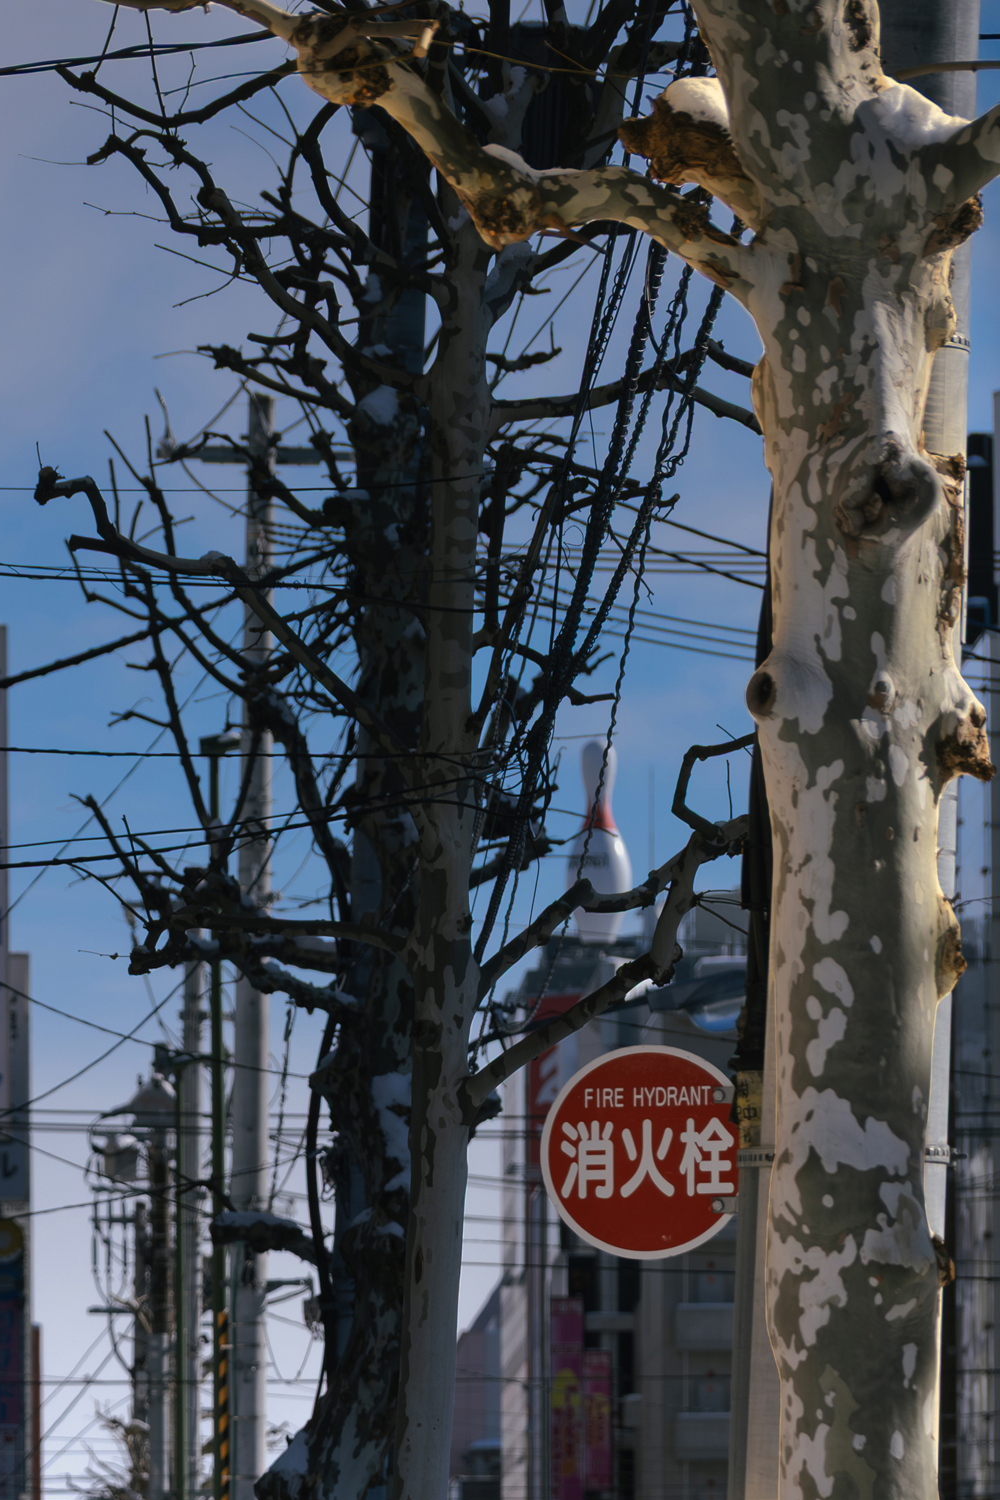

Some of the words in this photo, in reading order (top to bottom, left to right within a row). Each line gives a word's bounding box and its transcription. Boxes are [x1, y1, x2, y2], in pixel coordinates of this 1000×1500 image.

[584, 1088, 624, 1108] FIRE
[633, 1086, 711, 1107] HYDRANT
[560, 1117, 735, 1199] 消火栓
